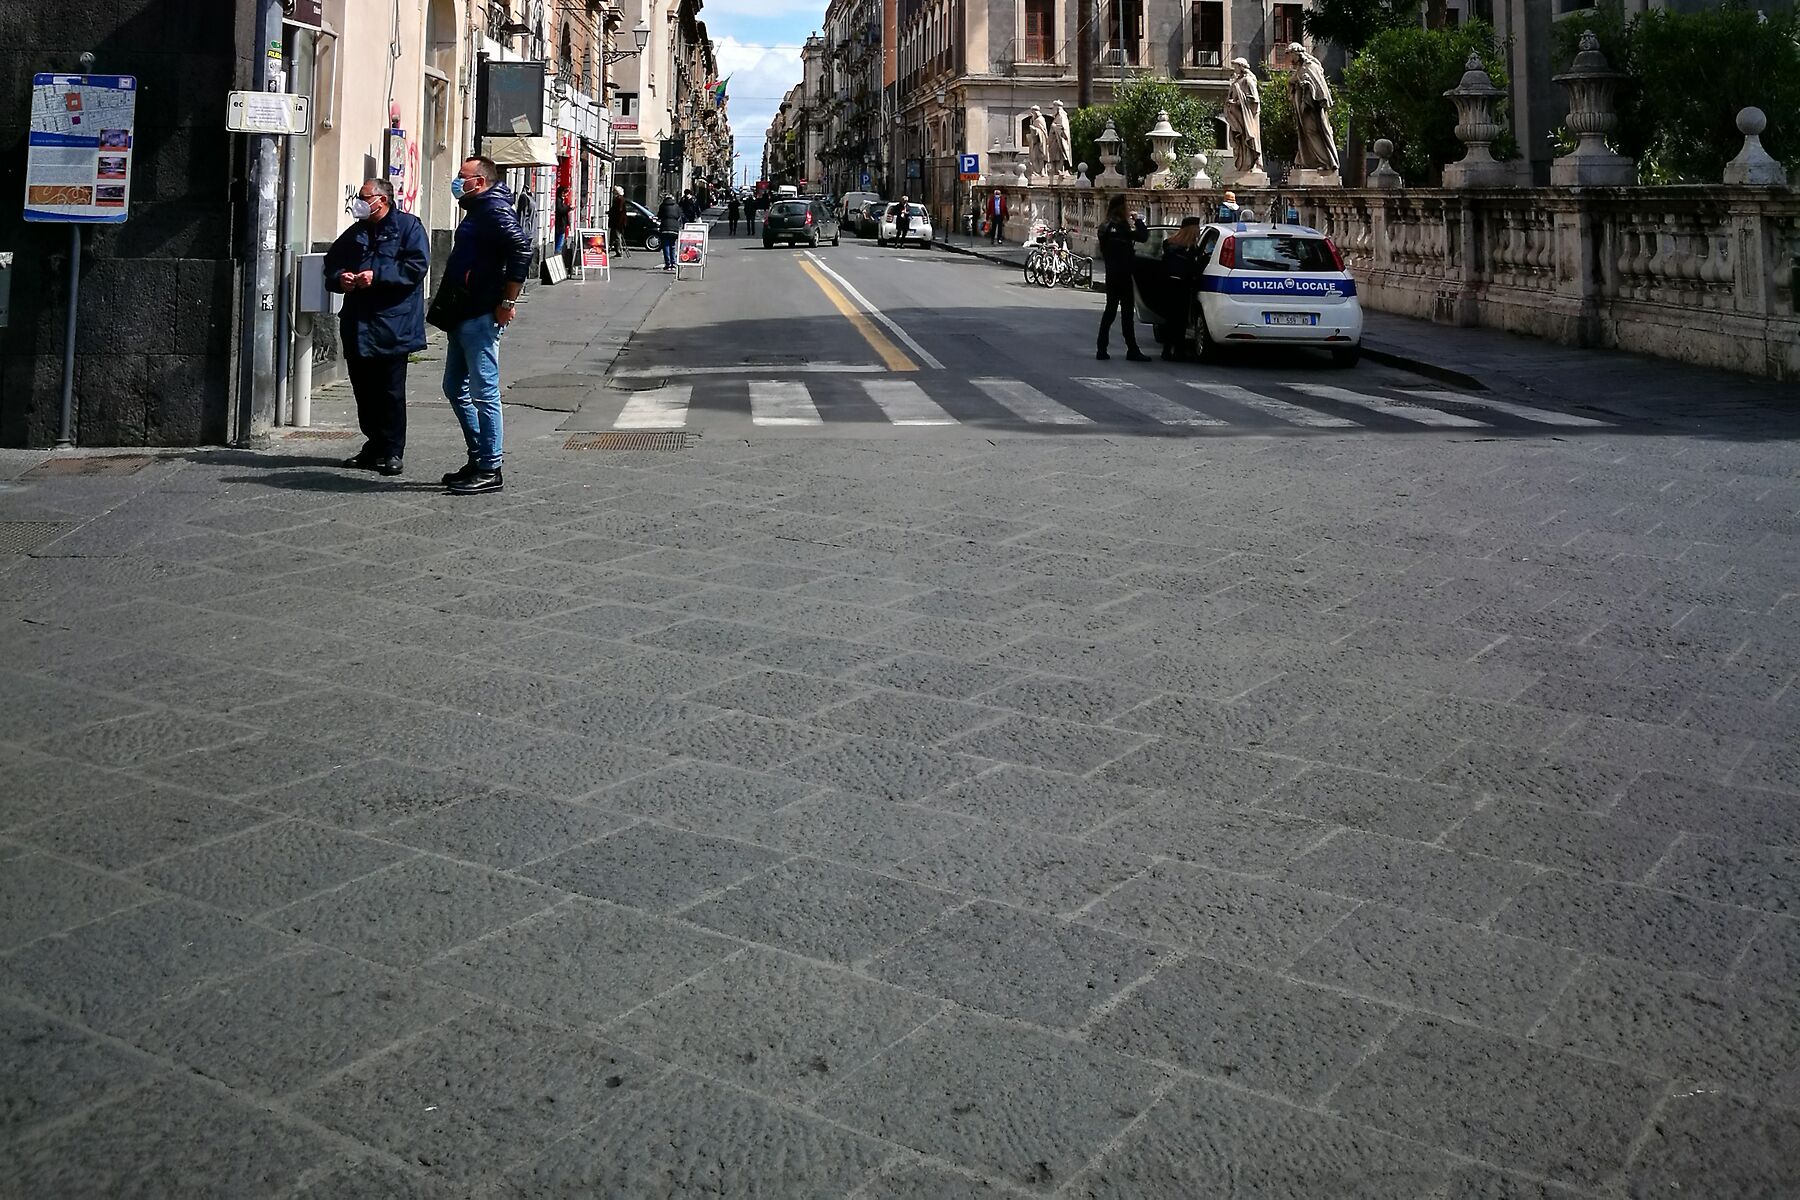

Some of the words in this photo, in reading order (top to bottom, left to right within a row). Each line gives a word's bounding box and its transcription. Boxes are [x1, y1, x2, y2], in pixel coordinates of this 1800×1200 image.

[615, 93, 638, 116] T
[964, 157, 975, 172] P
[863, 175, 870, 184] P
[1242, 281, 1284, 290] POLIZIA
[1296, 282, 1336, 291] LOCALE
